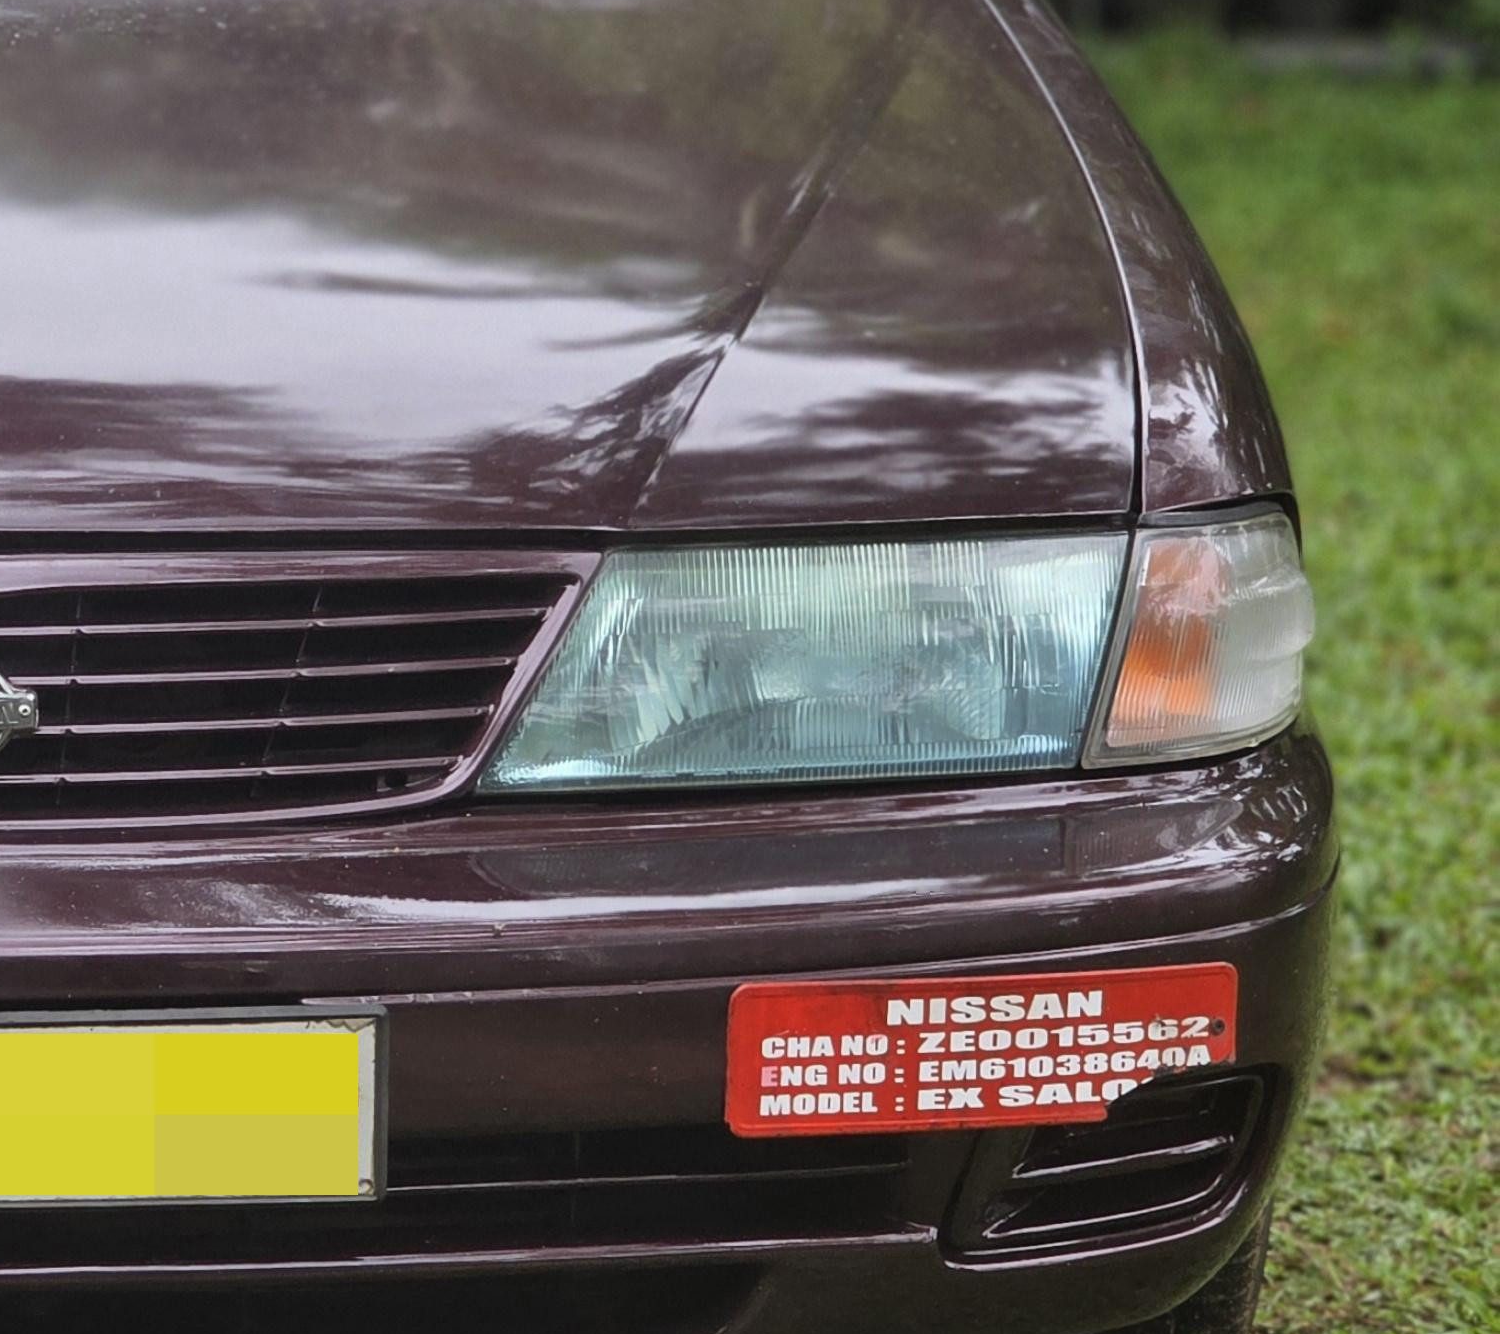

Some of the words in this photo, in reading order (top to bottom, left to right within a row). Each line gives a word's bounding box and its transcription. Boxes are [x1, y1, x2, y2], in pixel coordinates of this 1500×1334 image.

[887, 991, 1102, 1026] NISSAN
[761, 1036, 835, 1059] CHA
[840, 1034, 888, 1056] NO
[917, 1016, 1210, 1054] ZE0015562
[761, 1064, 828, 1087] ENG
[838, 1062, 886, 1085] NO
[918, 1045, 1211, 1082] EM61038640A
[759, 1092, 878, 1116] MODEL
[917, 1087, 984, 1110] EX
[998, 1077, 1153, 1107] SALO
